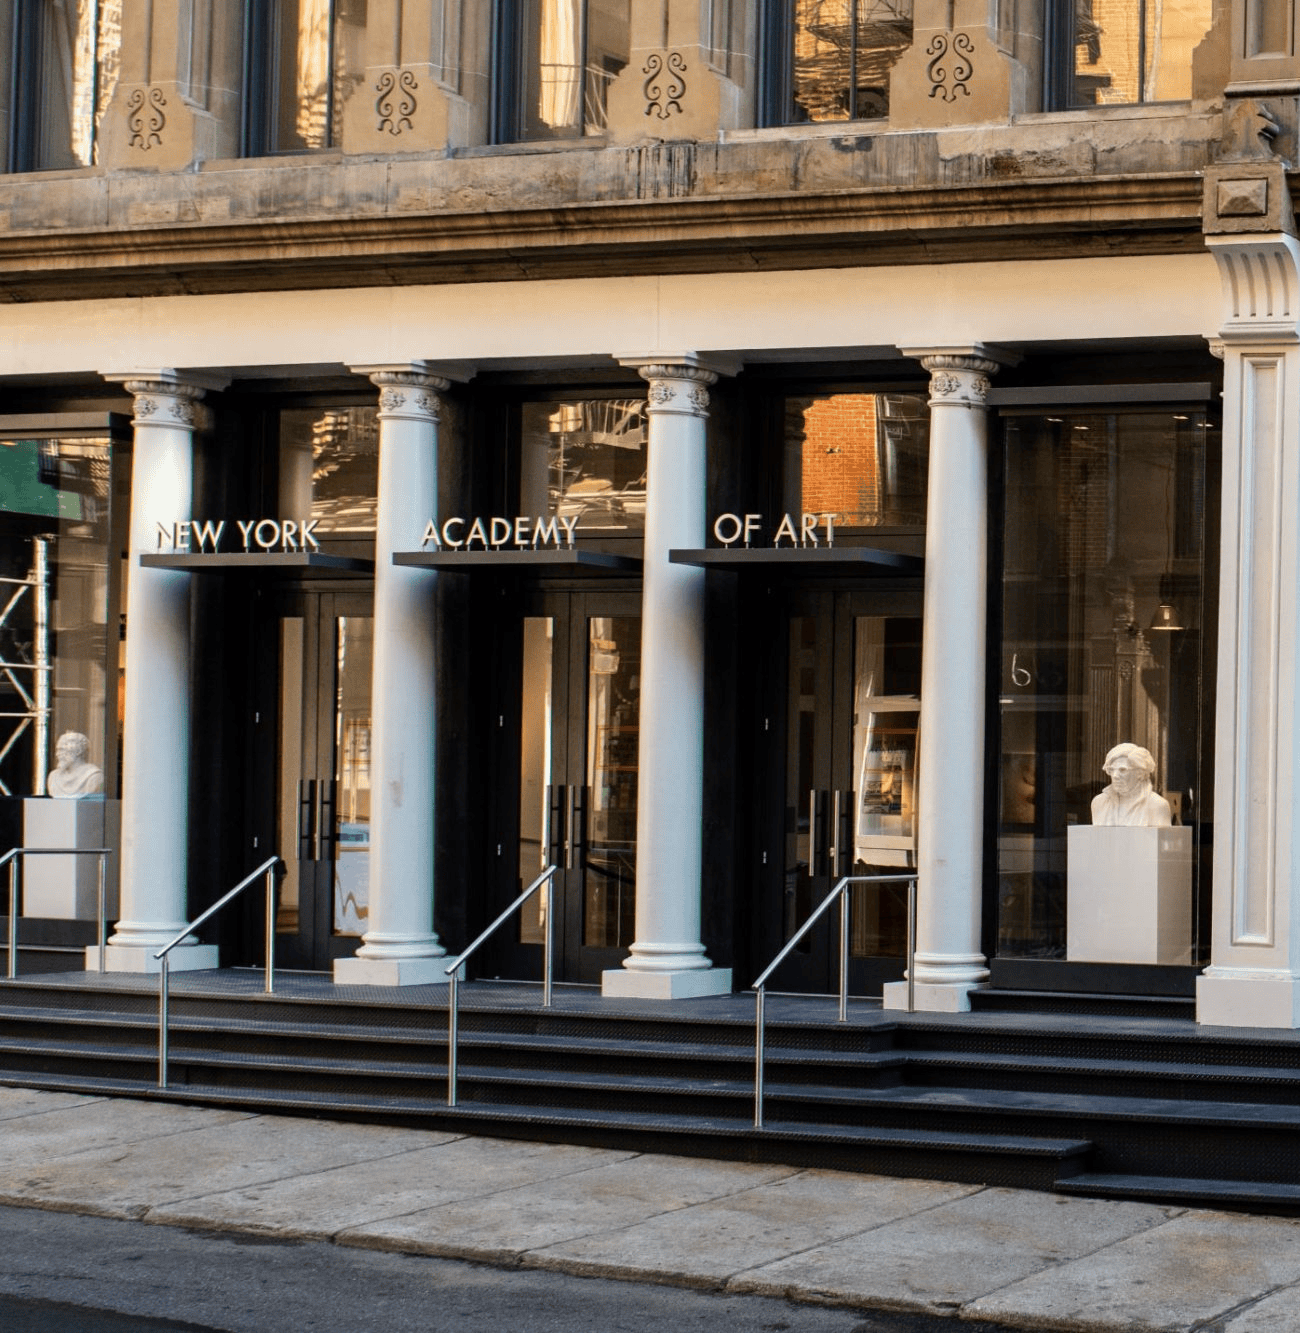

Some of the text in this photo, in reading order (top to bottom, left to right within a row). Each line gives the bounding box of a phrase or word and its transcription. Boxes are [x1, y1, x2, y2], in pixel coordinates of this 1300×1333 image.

[157, 519, 320, 550] NEW YORK
[421, 516, 578, 546] ACADEMY
[714, 512, 838, 543] OF ART
